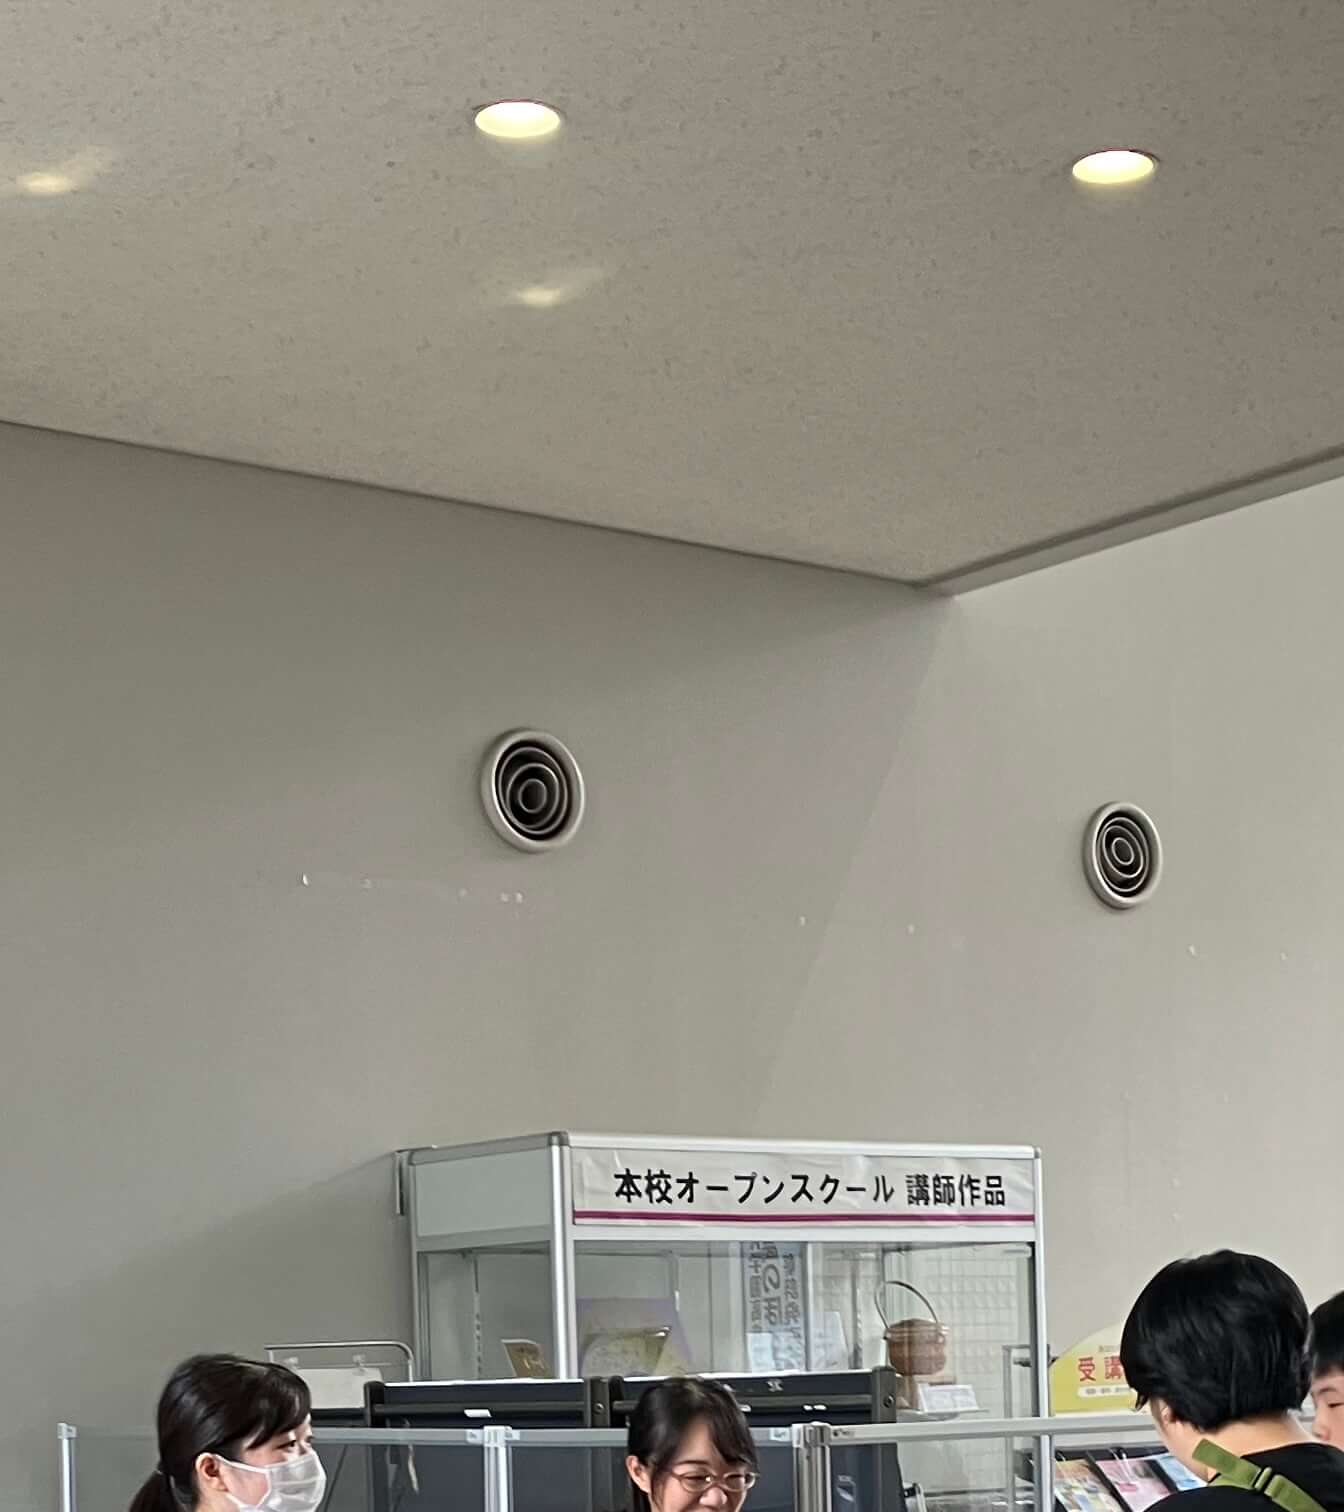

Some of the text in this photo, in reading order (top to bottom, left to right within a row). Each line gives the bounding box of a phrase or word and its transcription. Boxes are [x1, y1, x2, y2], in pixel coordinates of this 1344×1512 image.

[614, 1168, 1006, 1207] 本校オープンスクール 講師作品
